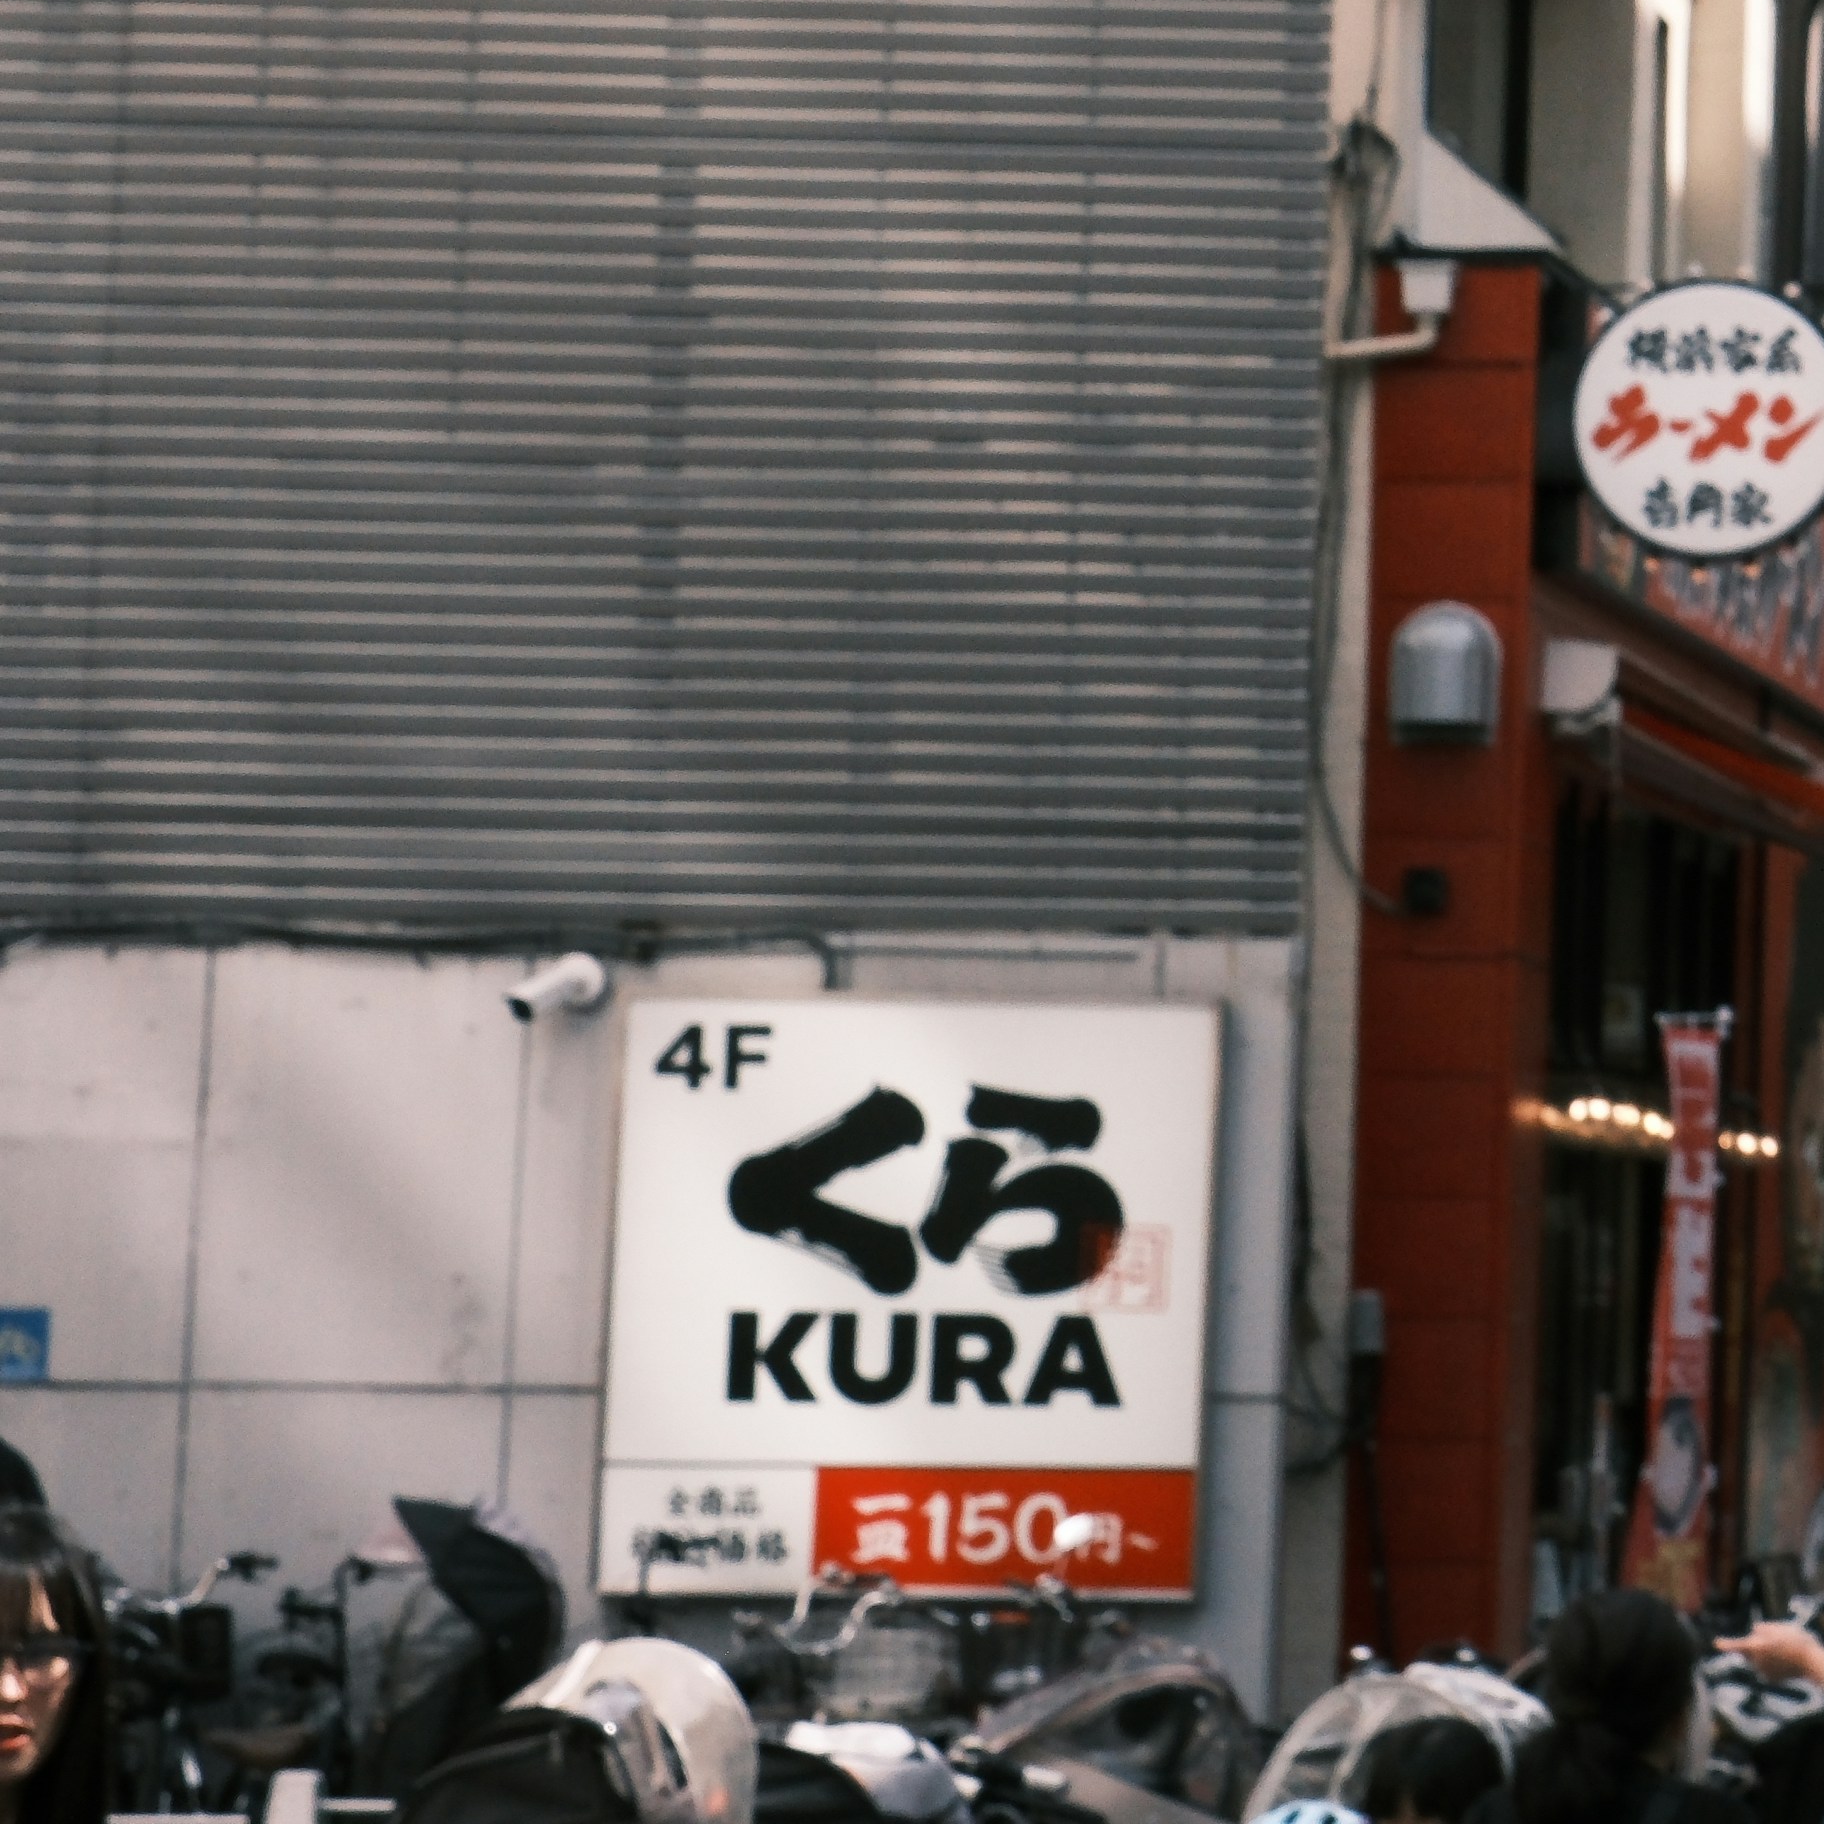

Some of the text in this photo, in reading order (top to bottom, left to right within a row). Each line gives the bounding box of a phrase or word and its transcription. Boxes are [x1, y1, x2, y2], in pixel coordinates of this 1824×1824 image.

[654, 1025, 772, 1089] 4F
[727, 1082, 1124, 1297] くら
[726, 1310, 1122, 1407] KURA
